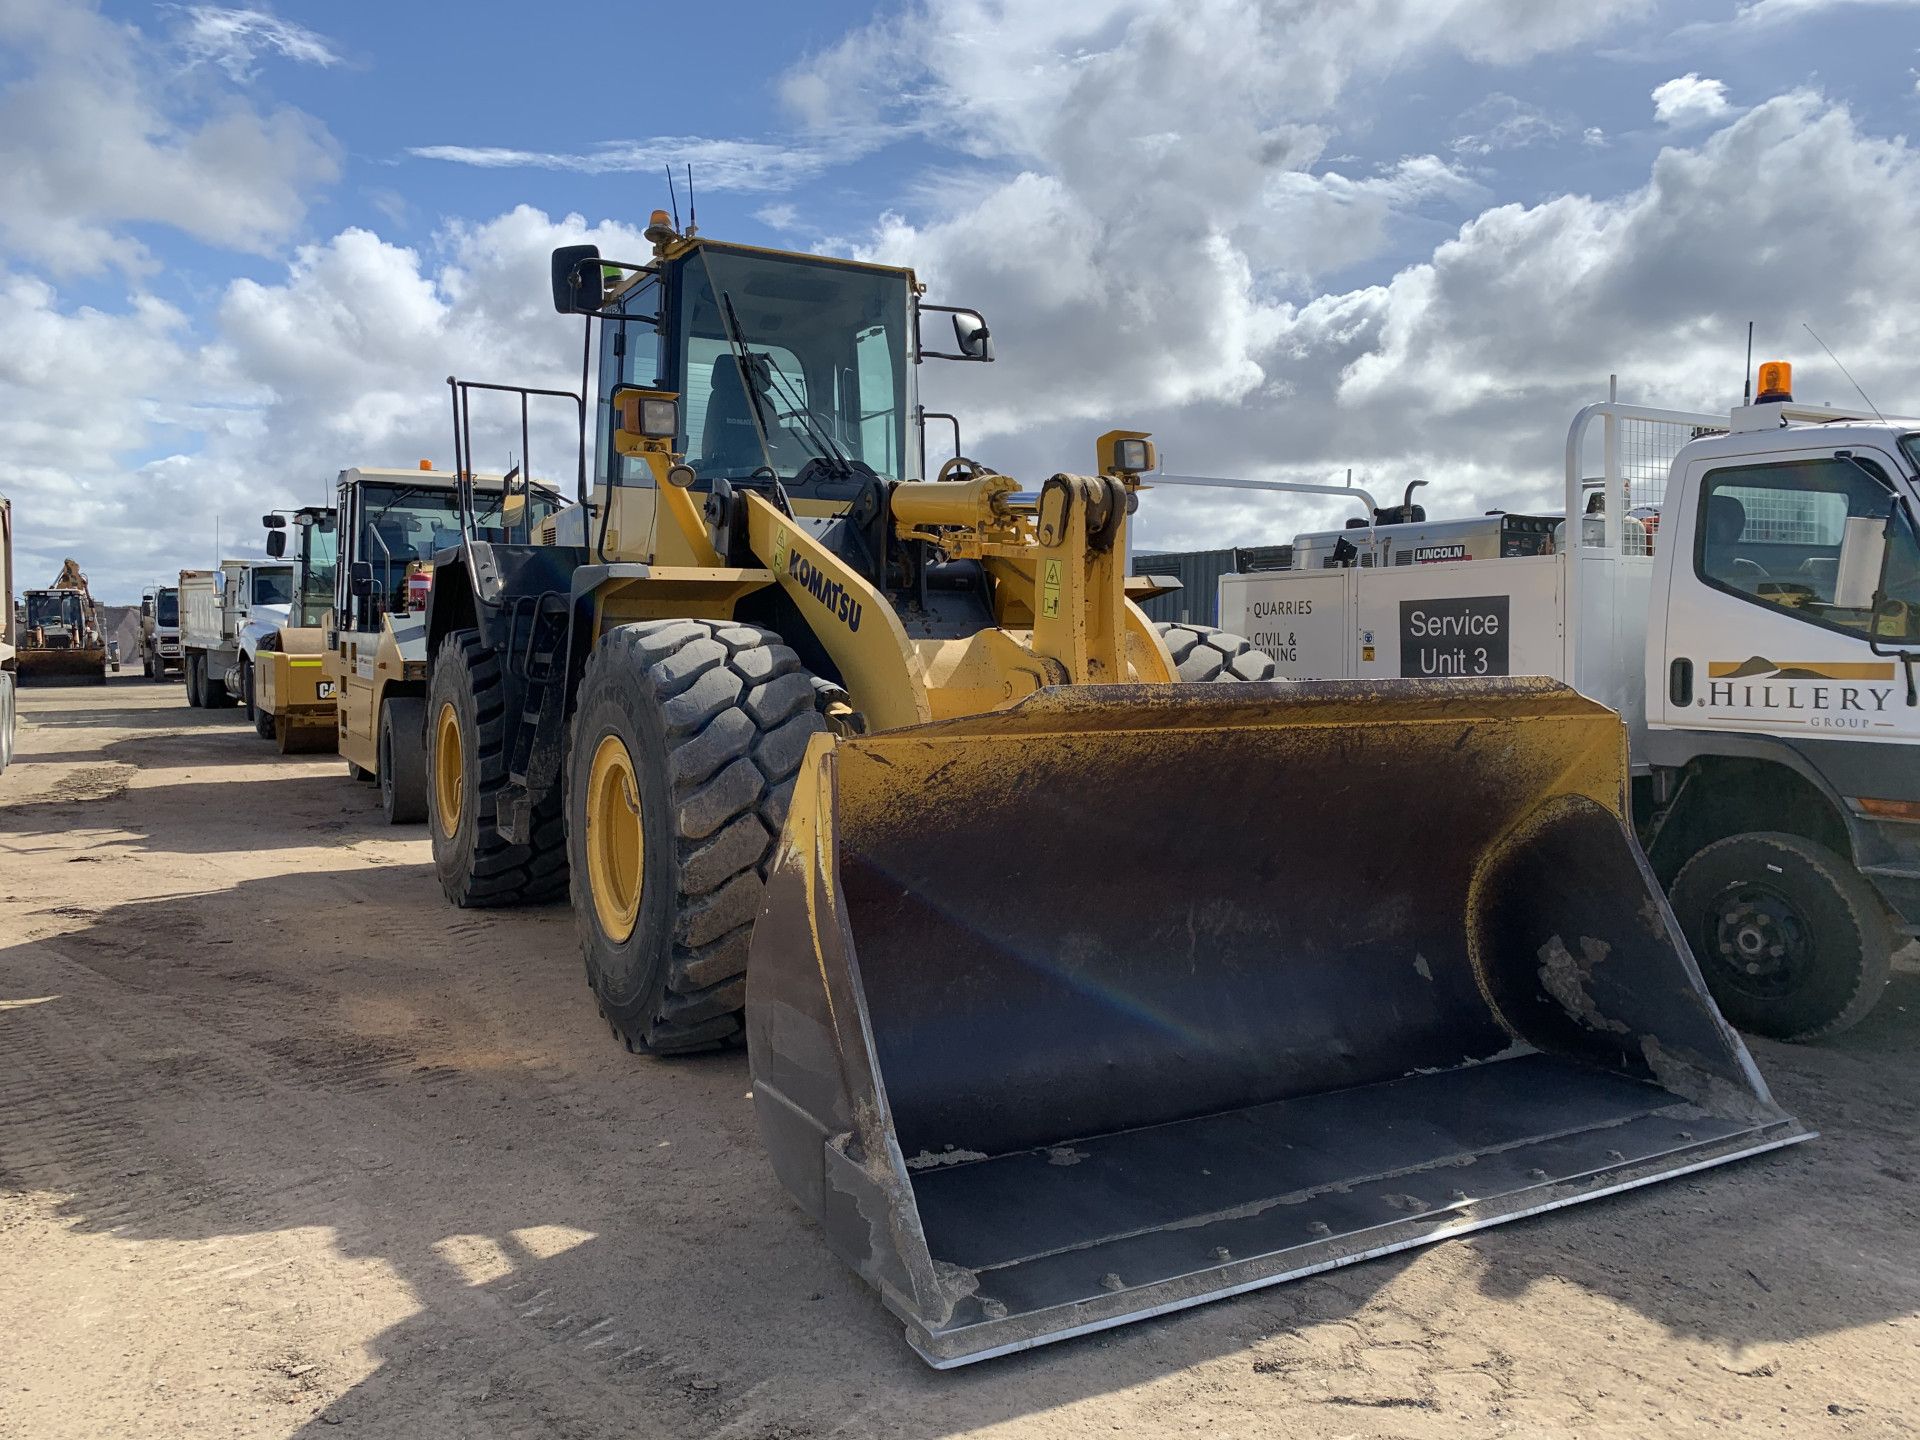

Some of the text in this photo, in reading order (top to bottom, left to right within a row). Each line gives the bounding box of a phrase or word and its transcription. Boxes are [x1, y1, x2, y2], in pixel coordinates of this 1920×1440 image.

[1416, 546, 1463, 560] LINCOLN
[788, 548, 862, 633] KOMATSU
[1253, 600, 1312, 618] QUARRIES
[1410, 608, 1499, 637] Service
[1254, 631, 1297, 646] CIVIL &
[1254, 647, 1297, 661] NING
[1420, 647, 1488, 674] Unit 3
[319, 682, 337, 698] CA
[1709, 681, 1895, 712] HILLERY
[1810, 716, 1870, 729] GROUP
